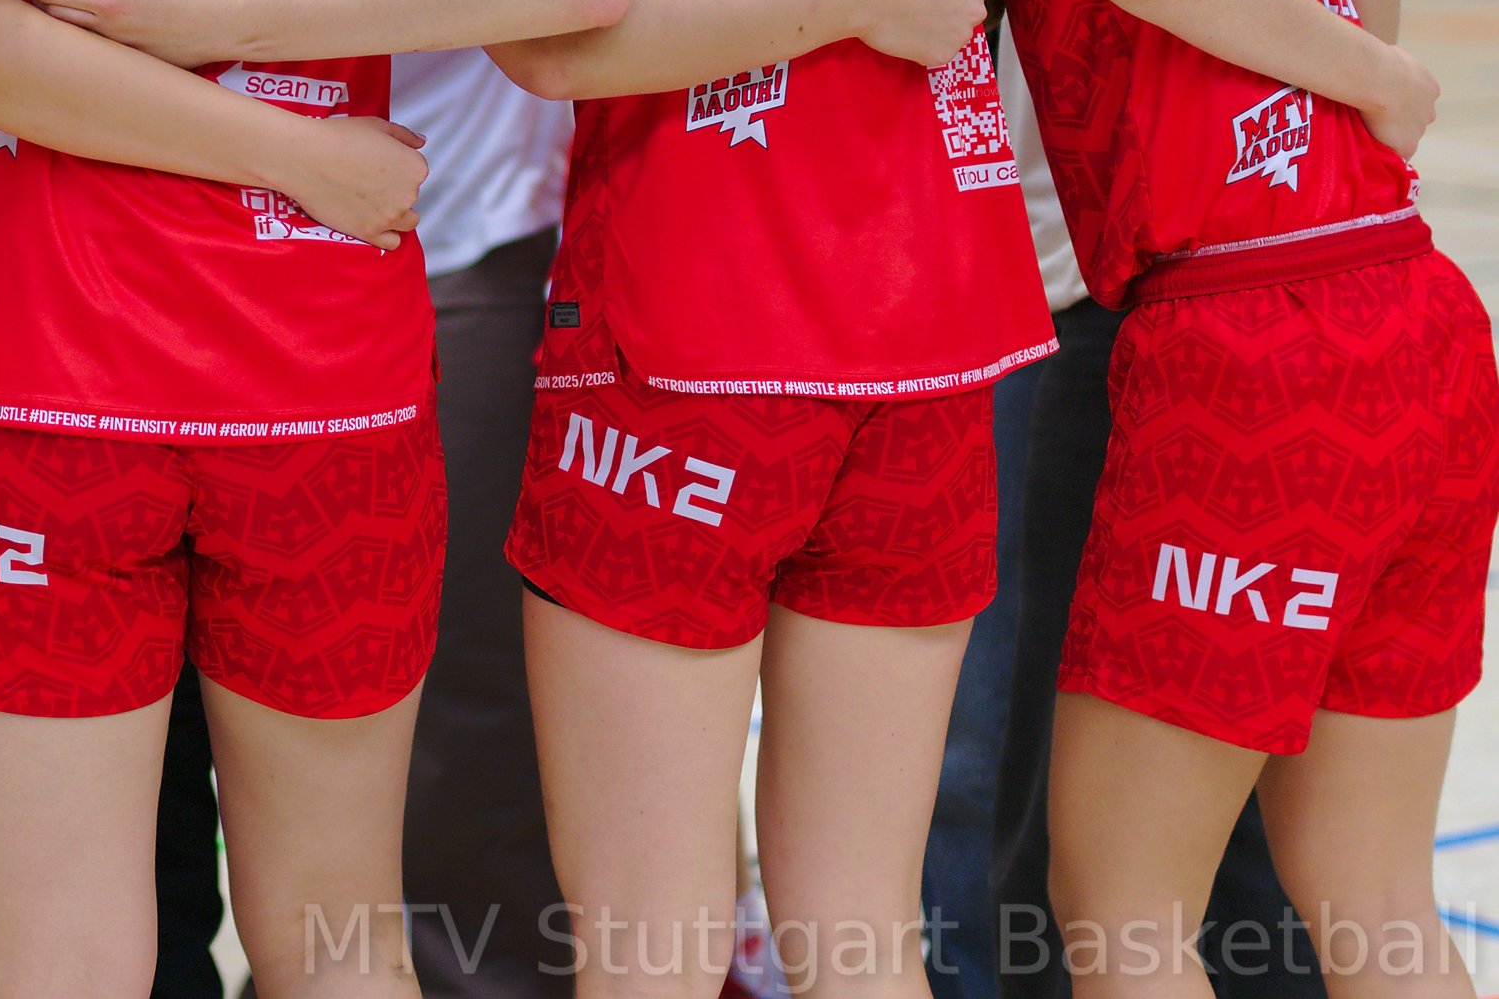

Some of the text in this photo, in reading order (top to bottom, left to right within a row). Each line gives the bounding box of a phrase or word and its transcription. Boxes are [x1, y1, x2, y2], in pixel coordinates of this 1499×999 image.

[245, 75, 309, 100] scan
[691, 68, 784, 123] AAOUH!
[257, 216, 275, 236] if
[551, 371, 616, 389] 2025/2026
[648, 375, 783, 395] #STRONGERTOGETHER
[784, 380, 836, 396] #HUSTLE
[837, 380, 896, 396] #DEFENSE
[896, 372, 960, 394] #INTENSITY
[961, 367, 983, 385] #FUN
[1014, 342, 1049, 364] SEASON
[29, 408, 97, 430] #DEFENSE
[98, 414, 177, 436] #INTENSITY
[179, 422, 217, 437] #FUN
[219, 422, 269, 438] #GROW
[271, 419, 326, 438] #FAMILY
[327, 415, 371, 433] SEASON
[371, 404, 418, 428] 2025/2026
[558, 412, 737, 527] NK2
[1152, 543, 1340, 631] NK2
